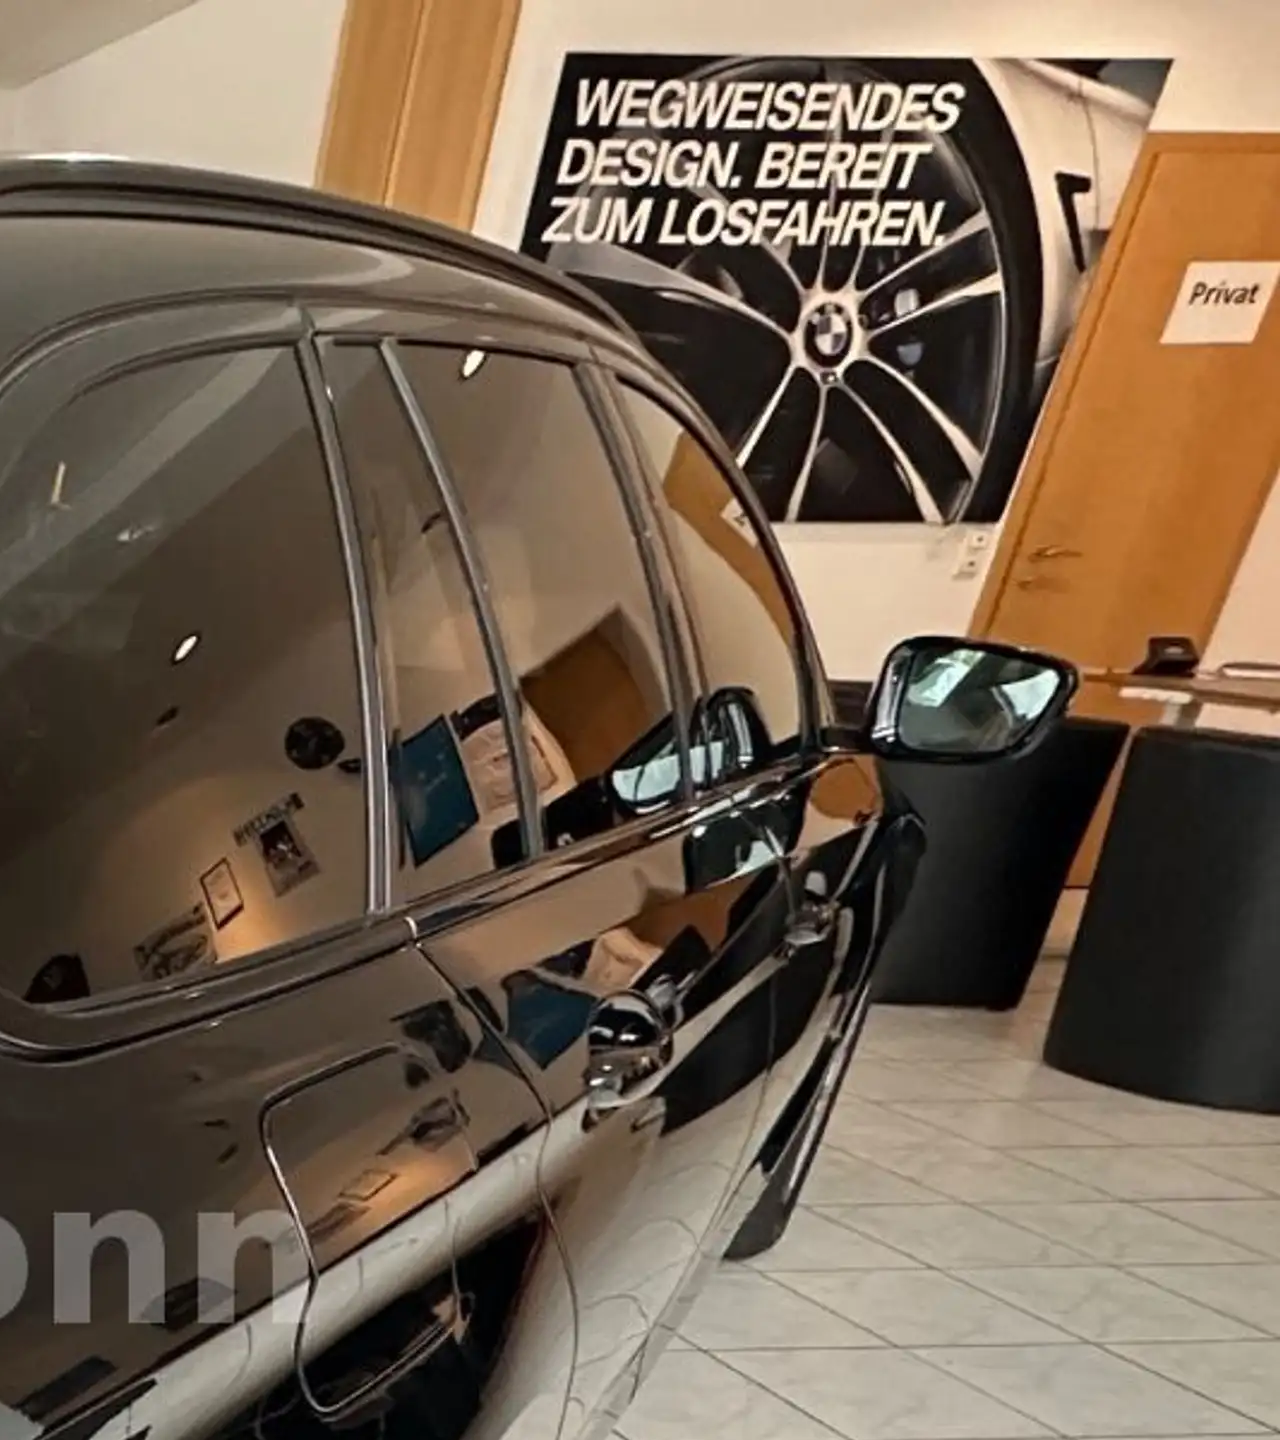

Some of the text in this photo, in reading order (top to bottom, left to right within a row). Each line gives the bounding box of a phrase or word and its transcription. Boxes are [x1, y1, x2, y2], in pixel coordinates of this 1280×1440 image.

[574, 78, 966, 131] WEGWEISENDES
[556, 138, 934, 189] DESIGN. BEREIT
[540, 196, 945, 248] ZUM LOSFAHREN.
[1188, 280, 1260, 305] Privat
